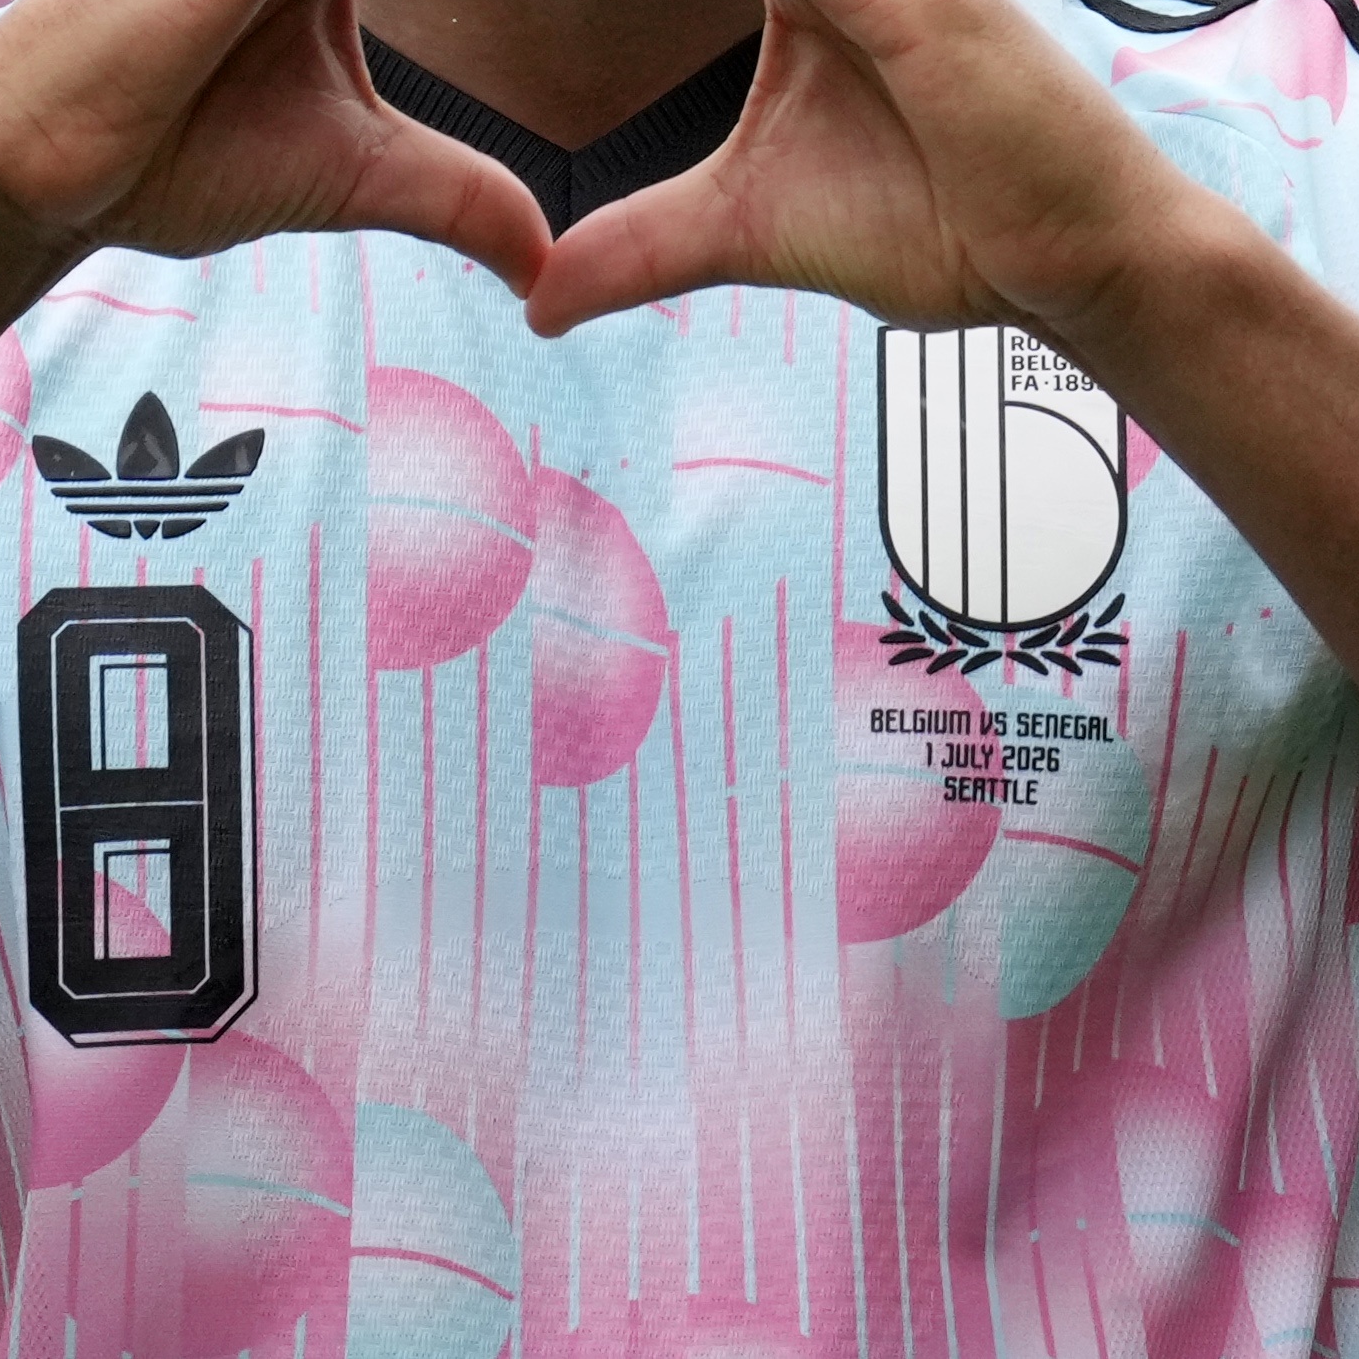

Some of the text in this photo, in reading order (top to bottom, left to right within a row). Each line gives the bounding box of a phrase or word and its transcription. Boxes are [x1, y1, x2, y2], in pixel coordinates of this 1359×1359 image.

[1011, 335, 1041, 351] RO
[1011, 355, 1069, 371] BELG
[870, 708, 1114, 743] BELGIUM VS SENEGAL
[925, 742, 1060, 772] 1 JULY 2026
[943, 775, 1038, 805] SEATTLE
[17, 585, 258, 1047] 8
